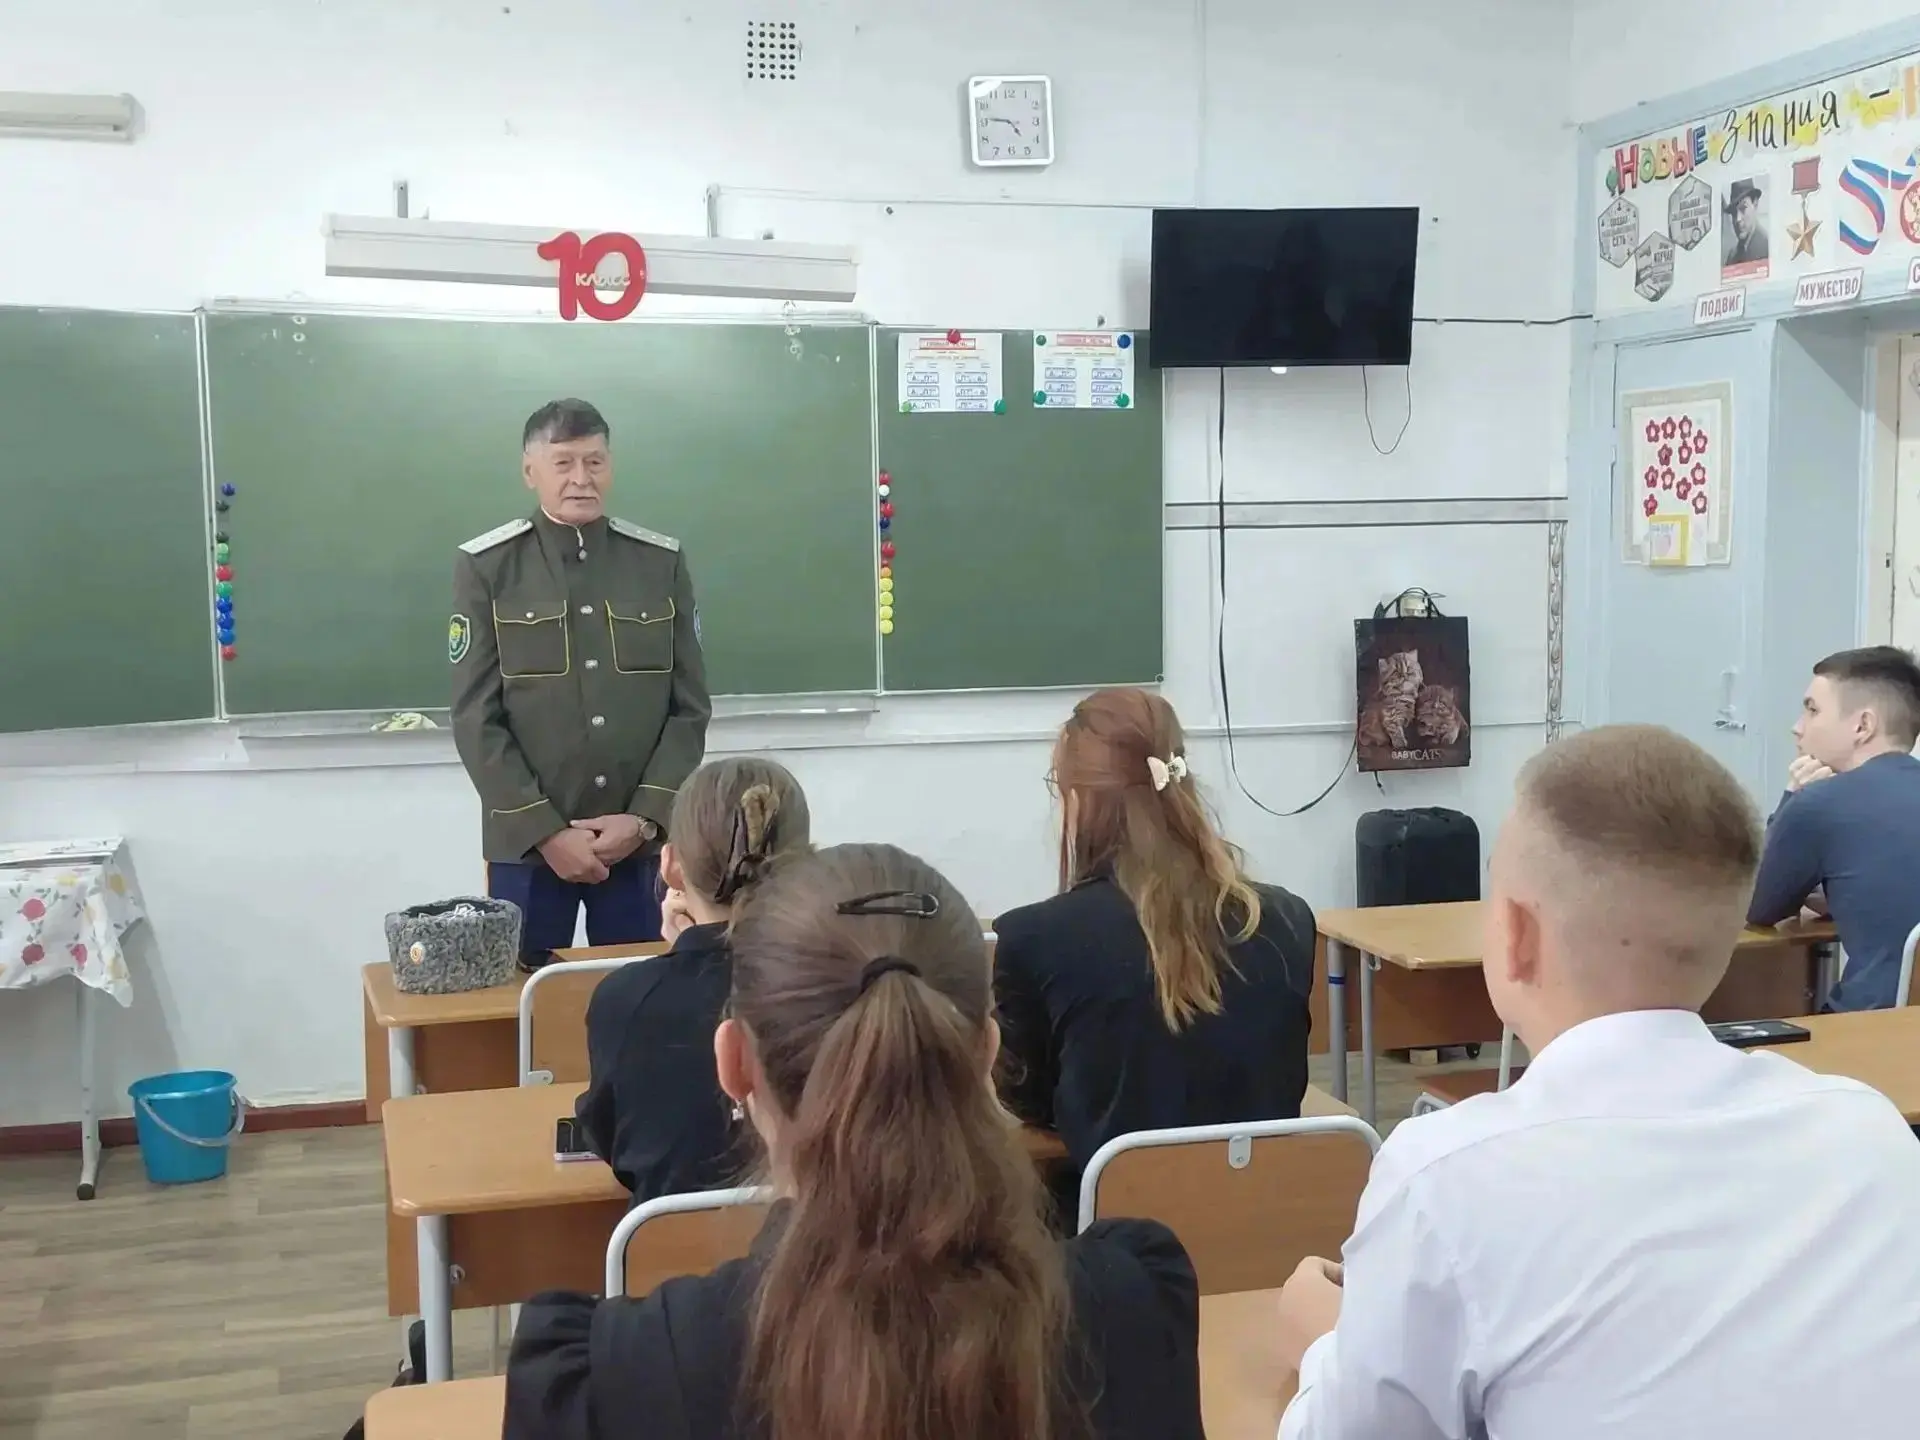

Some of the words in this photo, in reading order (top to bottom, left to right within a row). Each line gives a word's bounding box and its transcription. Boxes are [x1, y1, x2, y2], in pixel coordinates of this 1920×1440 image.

[1615, 125, 1708, 195] НОВЫЕ
[537, 231, 646, 321] 10
[1800, 277, 1859, 301] МУЖЕСТВО
[1700, 294, 1741, 317] ПОДВИГ
